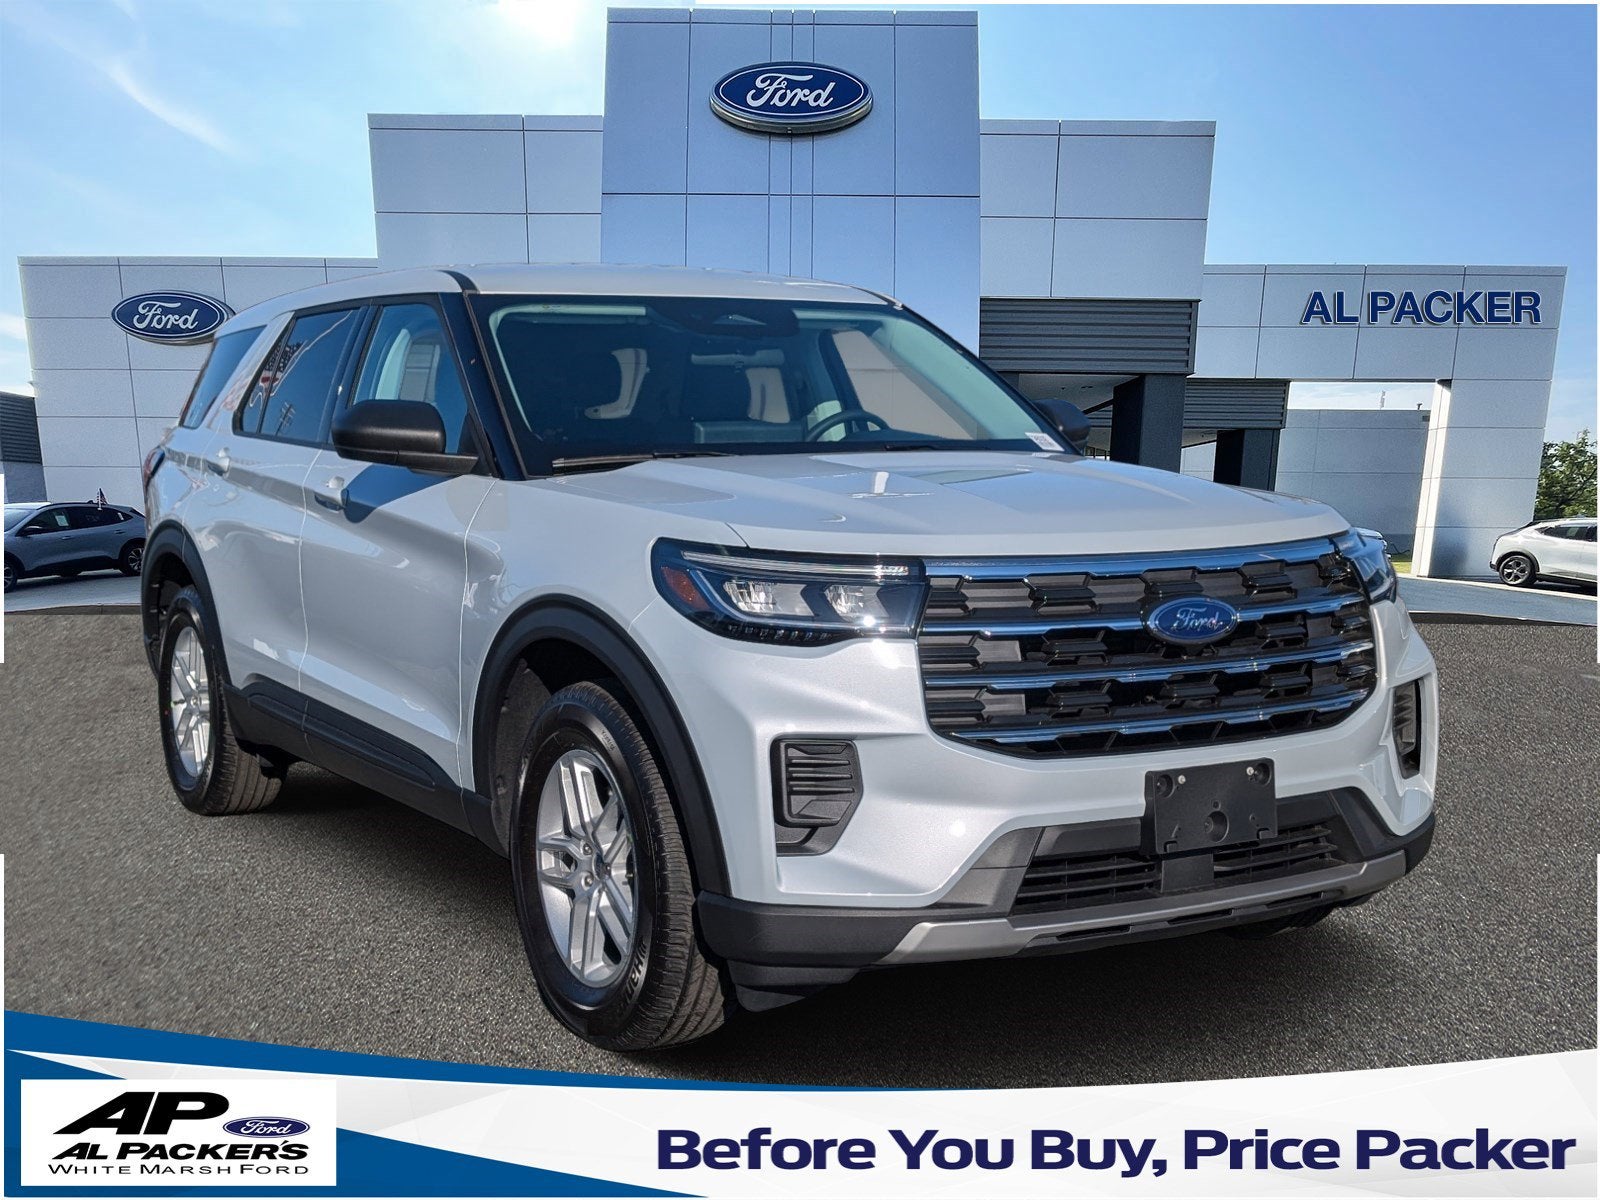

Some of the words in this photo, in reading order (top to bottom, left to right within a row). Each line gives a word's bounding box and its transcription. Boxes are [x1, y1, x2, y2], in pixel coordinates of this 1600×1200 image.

[746, 73, 836, 107] Ford
[133, 301, 199, 329] Ford
[1301, 290, 1360, 324] AL
[1368, 290, 1543, 325] PACKER
[1171, 607, 1223, 631] Ford
